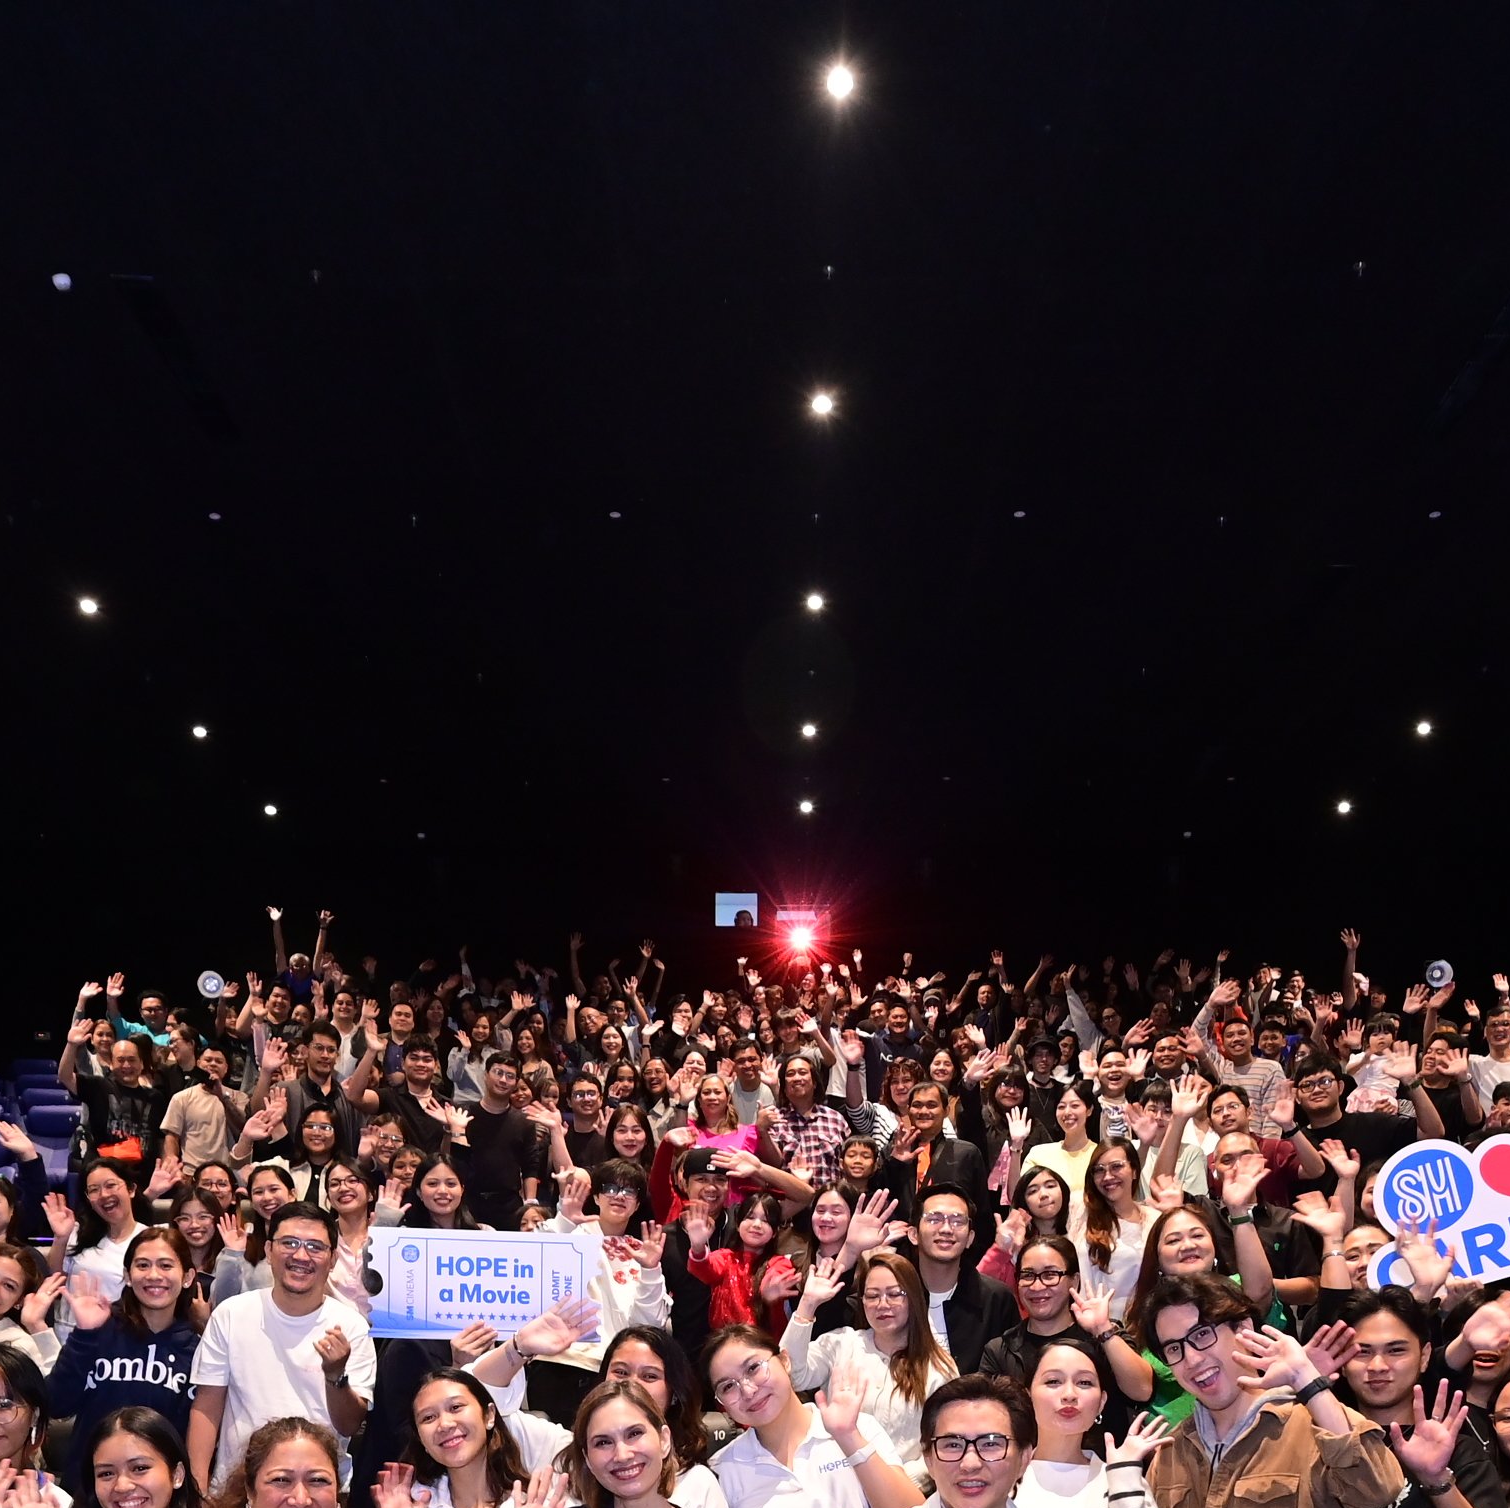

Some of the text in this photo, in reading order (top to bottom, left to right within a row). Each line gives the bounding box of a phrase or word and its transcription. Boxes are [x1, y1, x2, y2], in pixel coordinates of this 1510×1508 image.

[436, 1255, 534, 1279] HOPE in
[439, 1283, 531, 1305] a Movie
[552, 1269, 561, 1302] ADMIT
[564, 1275, 573, 1297] ONE
[713, 1429, 726, 1441] 10
[818, 1458, 851, 1474] HOPE
